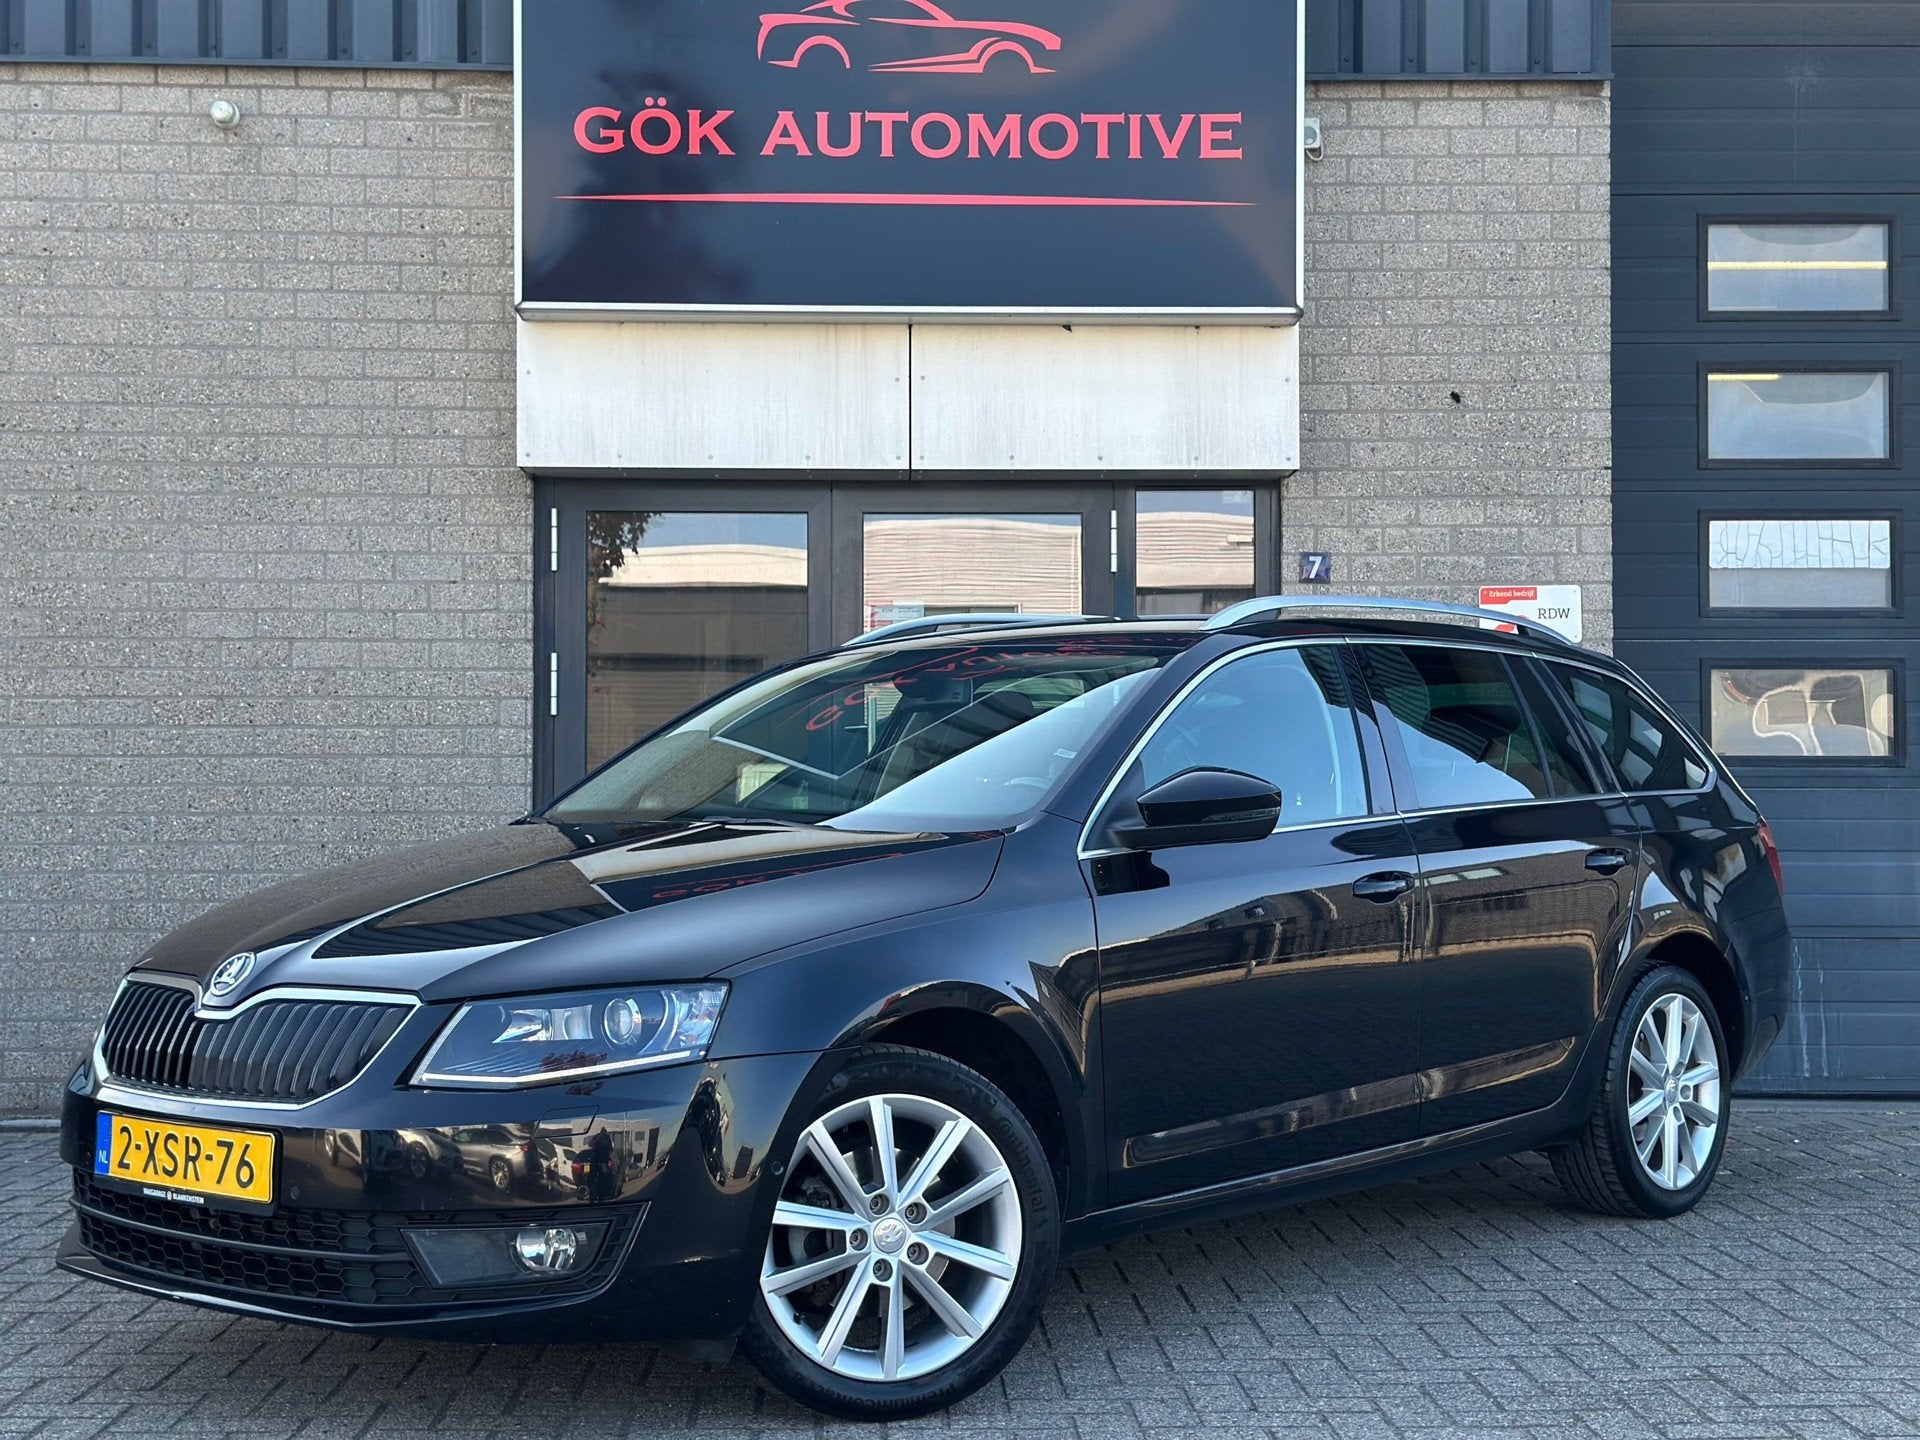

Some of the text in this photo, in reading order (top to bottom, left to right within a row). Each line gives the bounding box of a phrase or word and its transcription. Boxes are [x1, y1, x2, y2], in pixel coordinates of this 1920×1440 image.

[573, 97, 1243, 160] GÖK AUTOMOTIVE
[1309, 555, 1323, 579] 7
[1488, 589, 1535, 599] Erkend bedrijf
[1538, 608, 1570, 619] RDW
[98, 1150, 109, 1164] NL
[117, 1125, 255, 1189] 2-XSR-76
